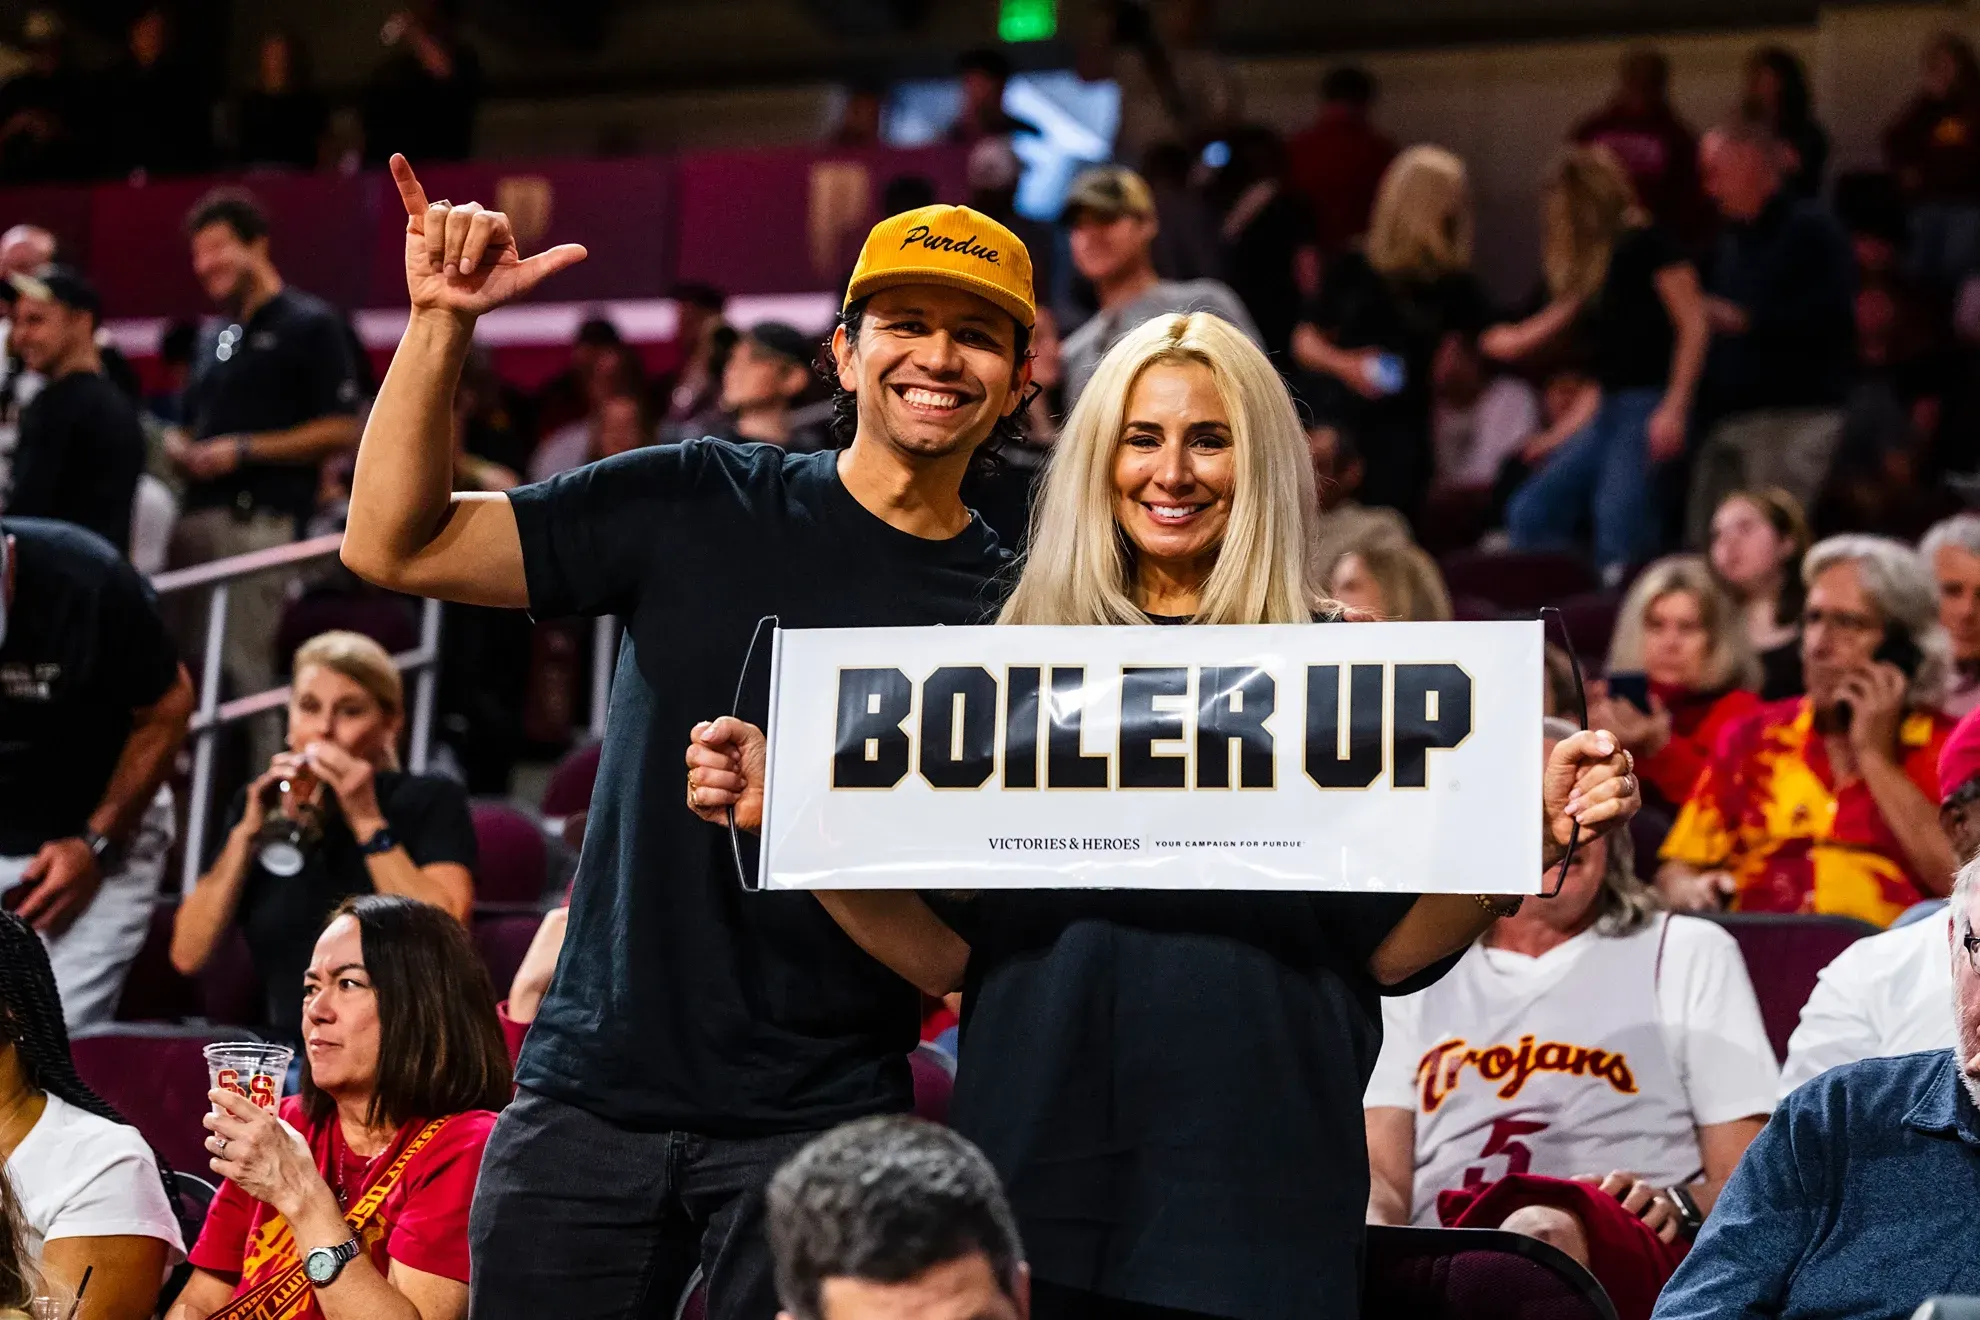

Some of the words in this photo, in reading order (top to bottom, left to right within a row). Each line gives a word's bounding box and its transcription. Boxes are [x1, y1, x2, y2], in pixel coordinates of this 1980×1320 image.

[899, 225, 1000, 263] Purdue
[829, 663, 1279, 792] BOILER
[1301, 660, 1476, 792] UP
[988, 837, 1067, 850] VICTORIES
[1068, 837, 1079, 850] &
[1082, 838, 1140, 850] HEROES
[1155, 840, 1182, 848] YOUR
[1184, 840, 1237, 848] CAMPAIGN
[1239, 840, 1259, 848] FOR
[1262, 840, 1301, 848] PURDUE
[1412, 1034, 1640, 1113] Trojans
